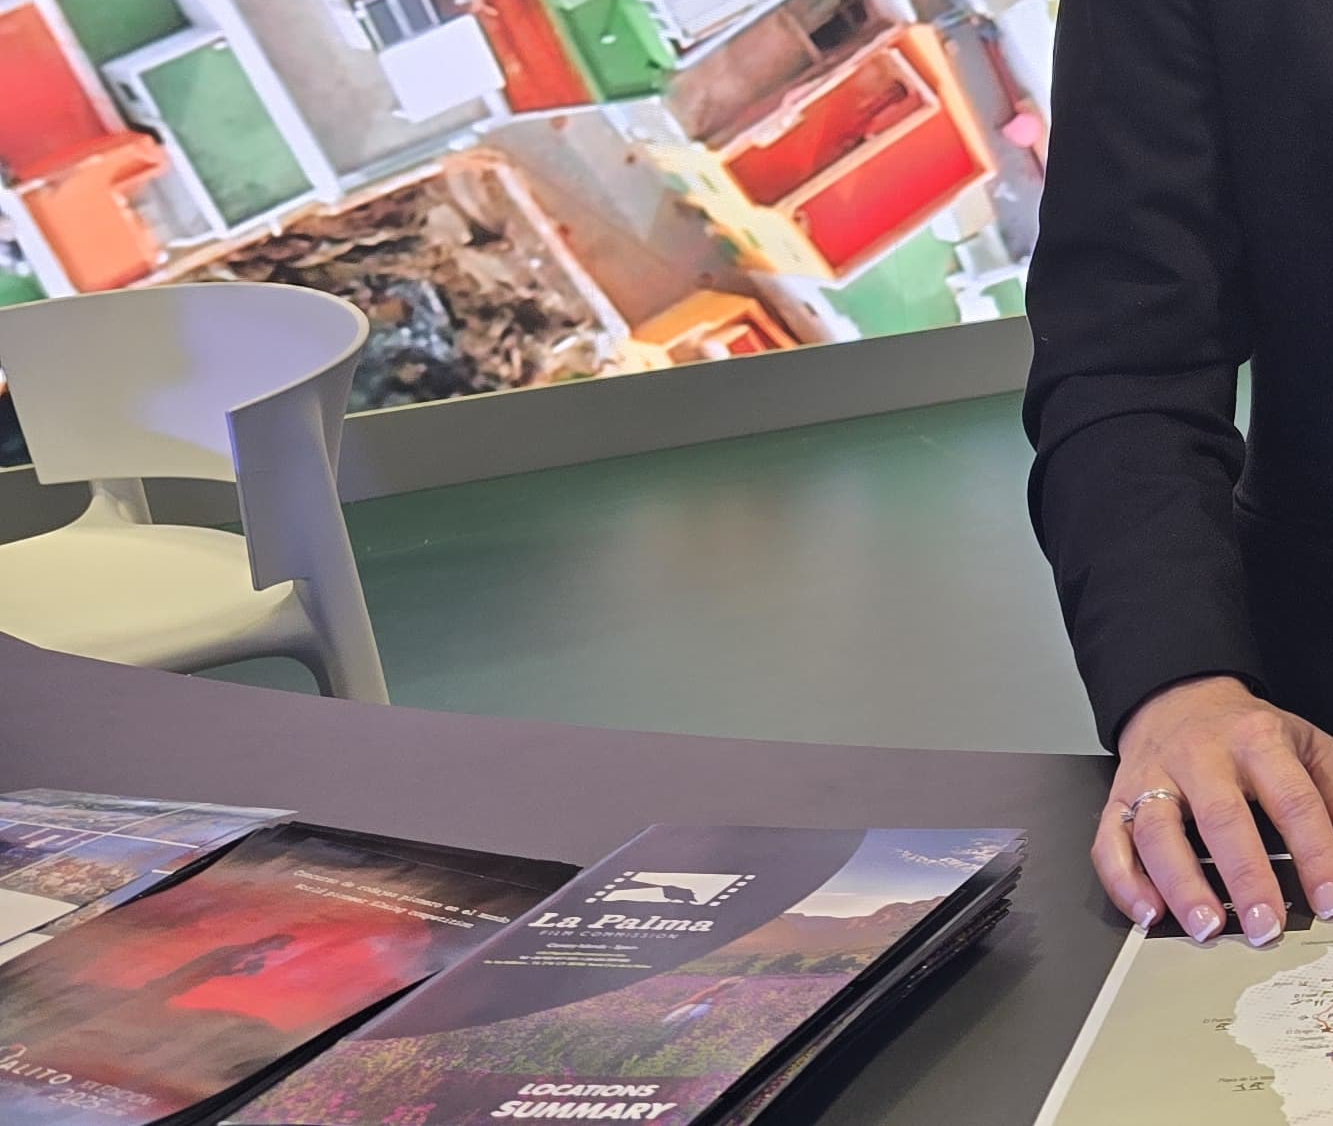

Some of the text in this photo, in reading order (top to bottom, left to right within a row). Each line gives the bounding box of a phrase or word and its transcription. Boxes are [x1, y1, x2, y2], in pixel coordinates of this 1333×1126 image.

[527, 912, 714, 932] La Palma
[538, 929, 680, 940] FILM COMMISSION
[517, 1083, 660, 1097] LOCATIONS
[490, 1100, 678, 1120] SUMMARY
